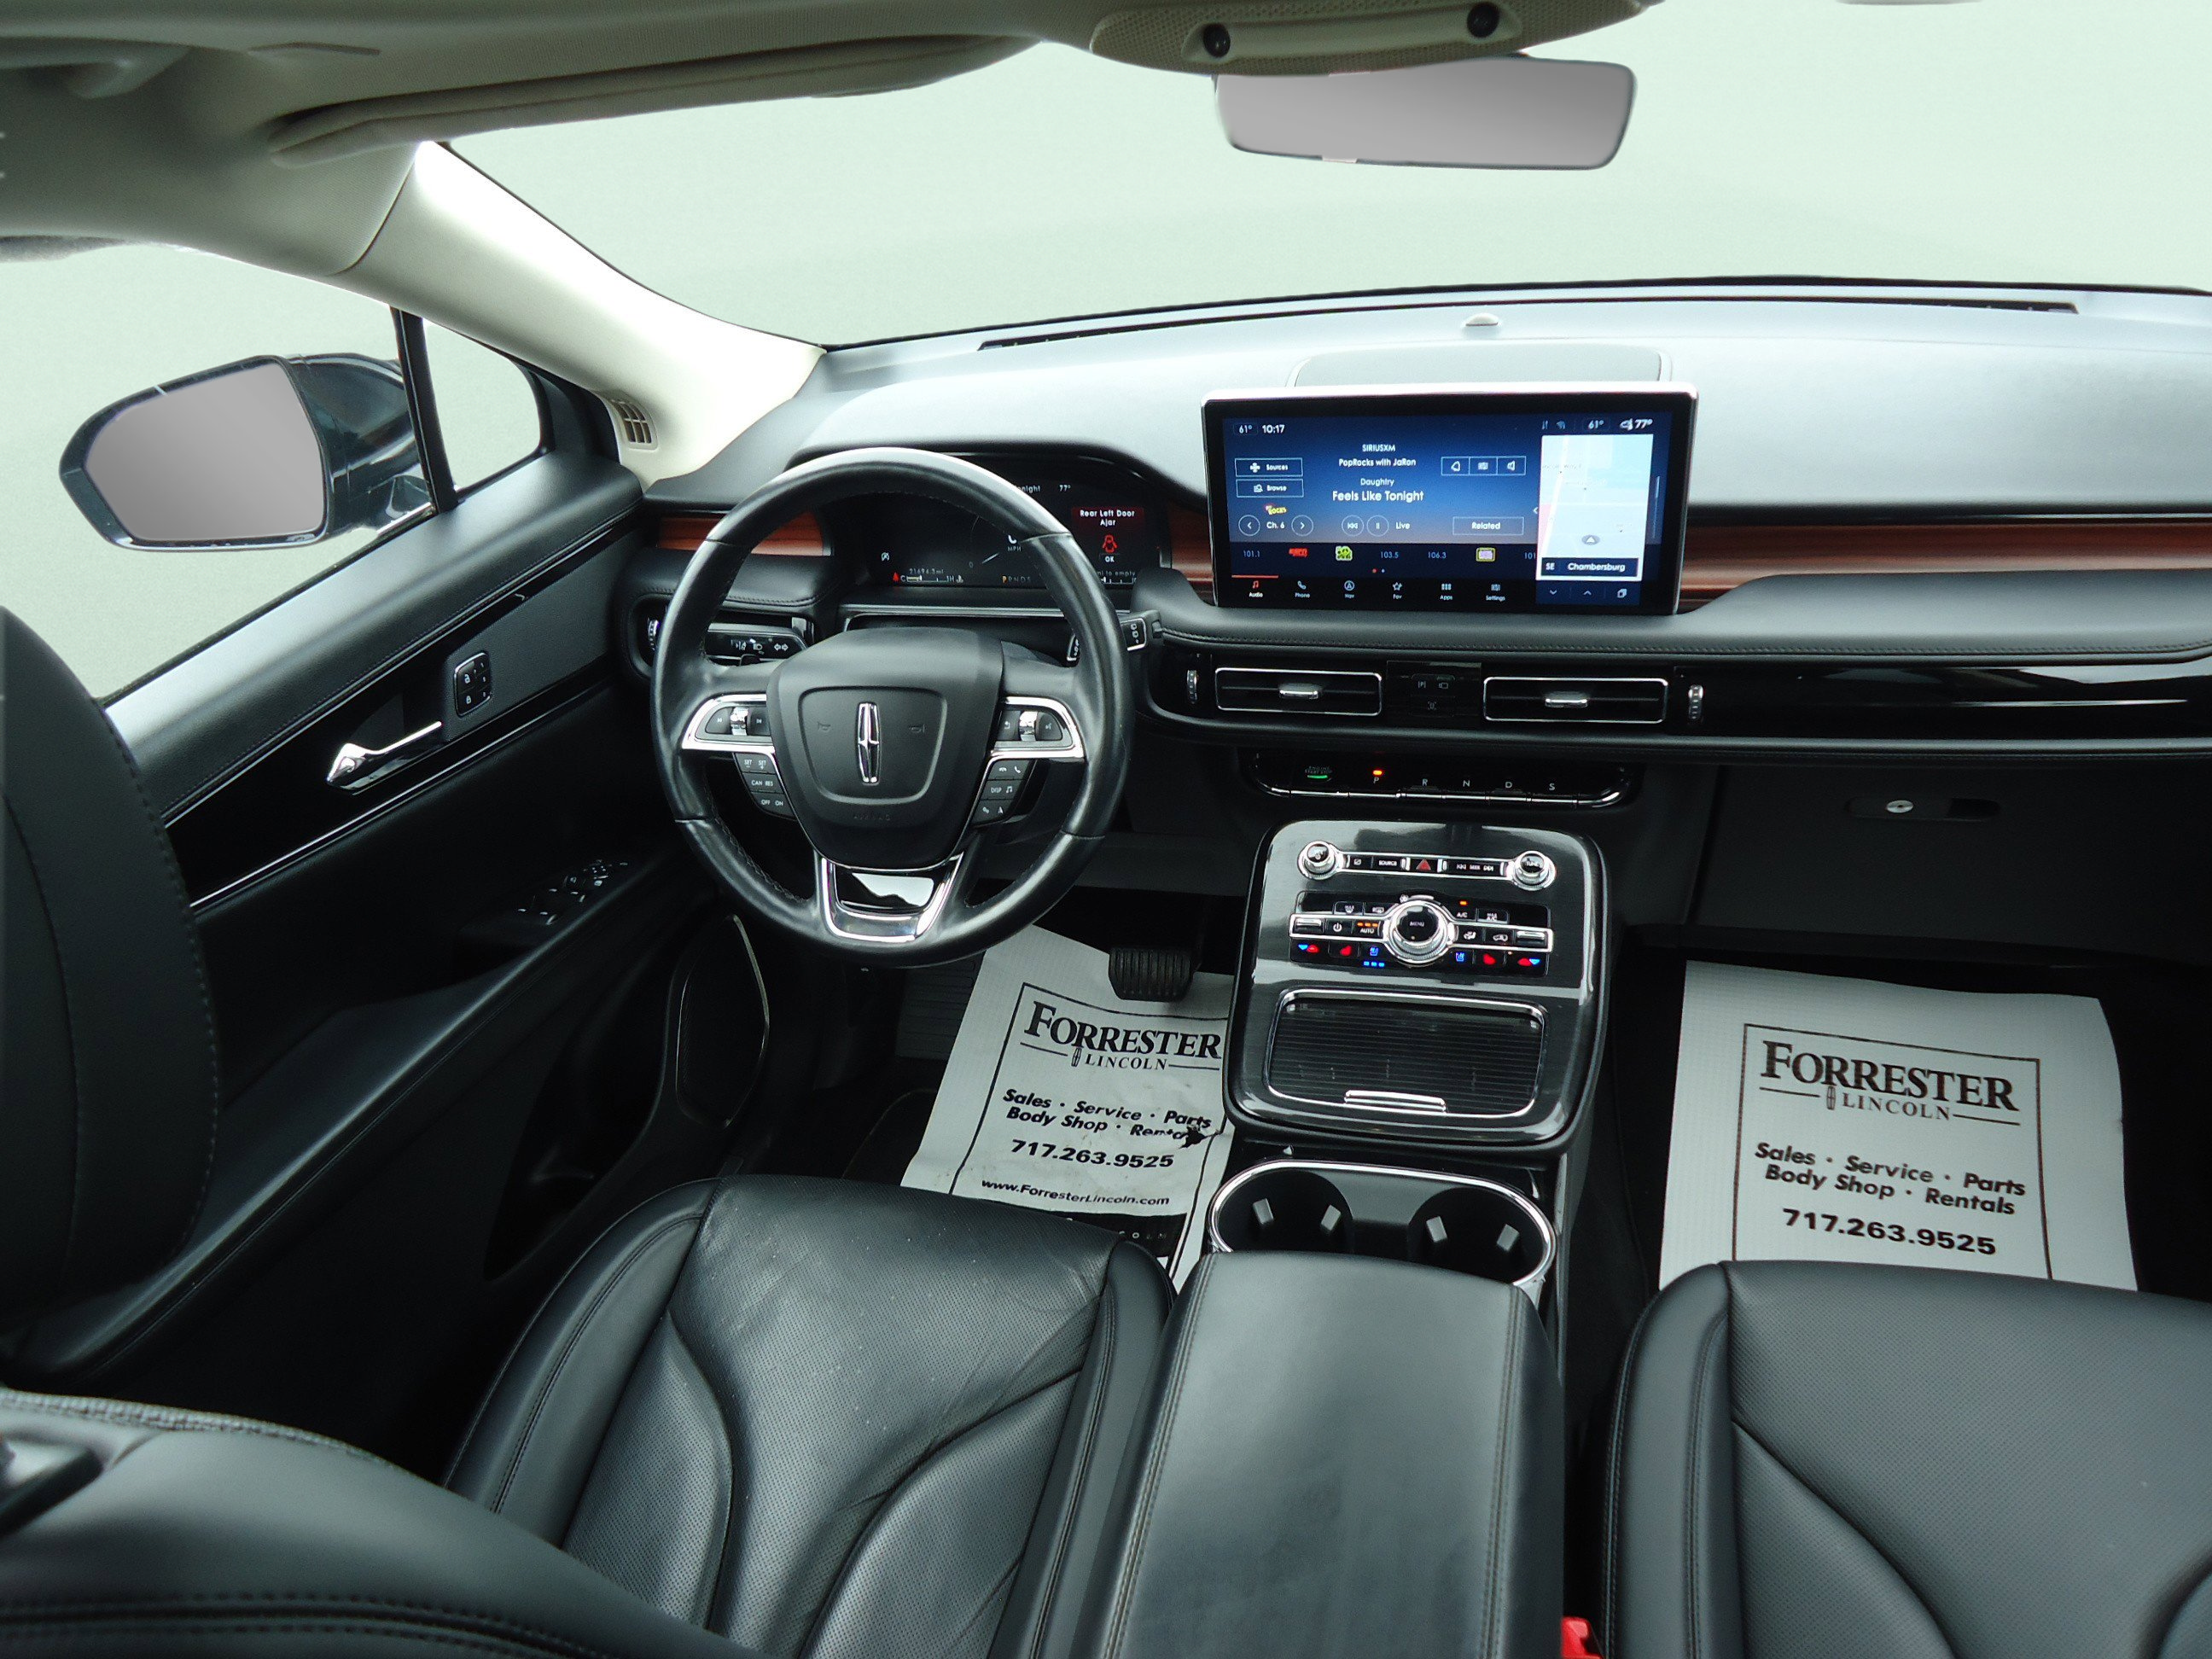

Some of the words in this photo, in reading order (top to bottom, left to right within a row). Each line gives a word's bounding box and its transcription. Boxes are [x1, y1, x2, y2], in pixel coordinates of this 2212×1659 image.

[1262, 424, 1285, 434] 10:17
[1362, 444, 1396, 452] SIRIUSXM
[1339, 458, 1374, 468] PopRocks
[1375, 458, 1391, 467] with
[1393, 458, 1417, 467] JaRon
[1360, 478, 1394, 487] Daughtry
[1332, 491, 1359, 502] Feels
[1361, 491, 1382, 502] Like
[1384, 490, 1424, 504] Tonight
[1100, 519, 1116, 527] Ajar
[1279, 521, 1285, 530] 6
[1395, 521, 1411, 530] Live
[1471, 521, 1501, 530] Related
[1545, 562, 1555, 571] SE
[1568, 562, 1626, 573] Chambersburg
[1463, 779, 1470, 788] N
[1023, 1000, 1223, 1060] FORRESTER
[1085, 1053, 1168, 1071] LINCOLN
[1761, 1040, 2020, 1112] FORRESTER
[1003, 1088, 1052, 1109] Sales
[1074, 1100, 1142, 1121] Service
[1163, 1109, 1213, 1129] Parts
[1842, 1091, 1951, 1121] LINCOLN
[1006, 1107, 1056, 1127] Body
[1060, 1115, 1108, 1133] Shop
[1010, 1138, 1174, 1169] 717.263.9525
[1755, 1142, 1816, 1167] Sales
[1844, 1154, 1934, 1184] Service
[1963, 1173, 2026, 1196] Parts
[981, 1178, 1170, 1206] www.ForresterLincoln.com
[1765, 1164, 1827, 1191] Body
[1834, 1173, 1895, 1200] Shop
[1924, 1188, 2016, 1215] Rentals
[1782, 1208, 1997, 1256] 717.263.9525
